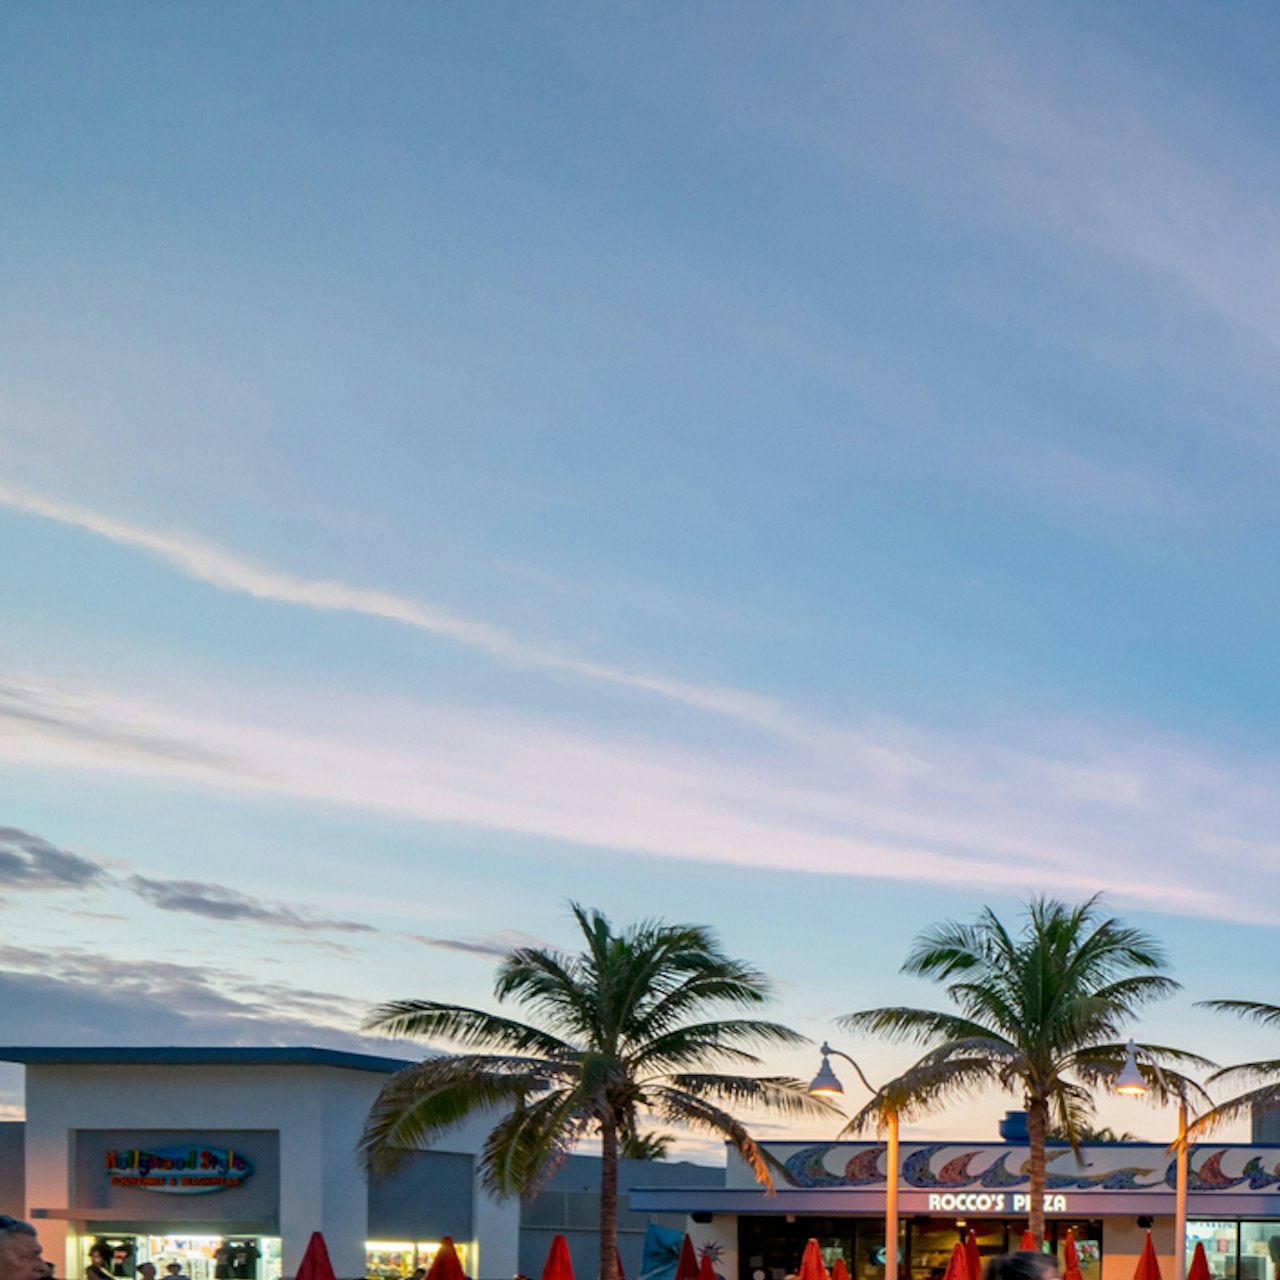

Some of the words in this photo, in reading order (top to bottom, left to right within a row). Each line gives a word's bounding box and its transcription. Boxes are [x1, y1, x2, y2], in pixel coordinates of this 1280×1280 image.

[105, 1150, 196, 1176] Hollywood
[201, 1150, 247, 1175] Style
[928, 1193, 1004, 1211] ROCCO'S
[1013, 1194, 1066, 1212] PIZA
